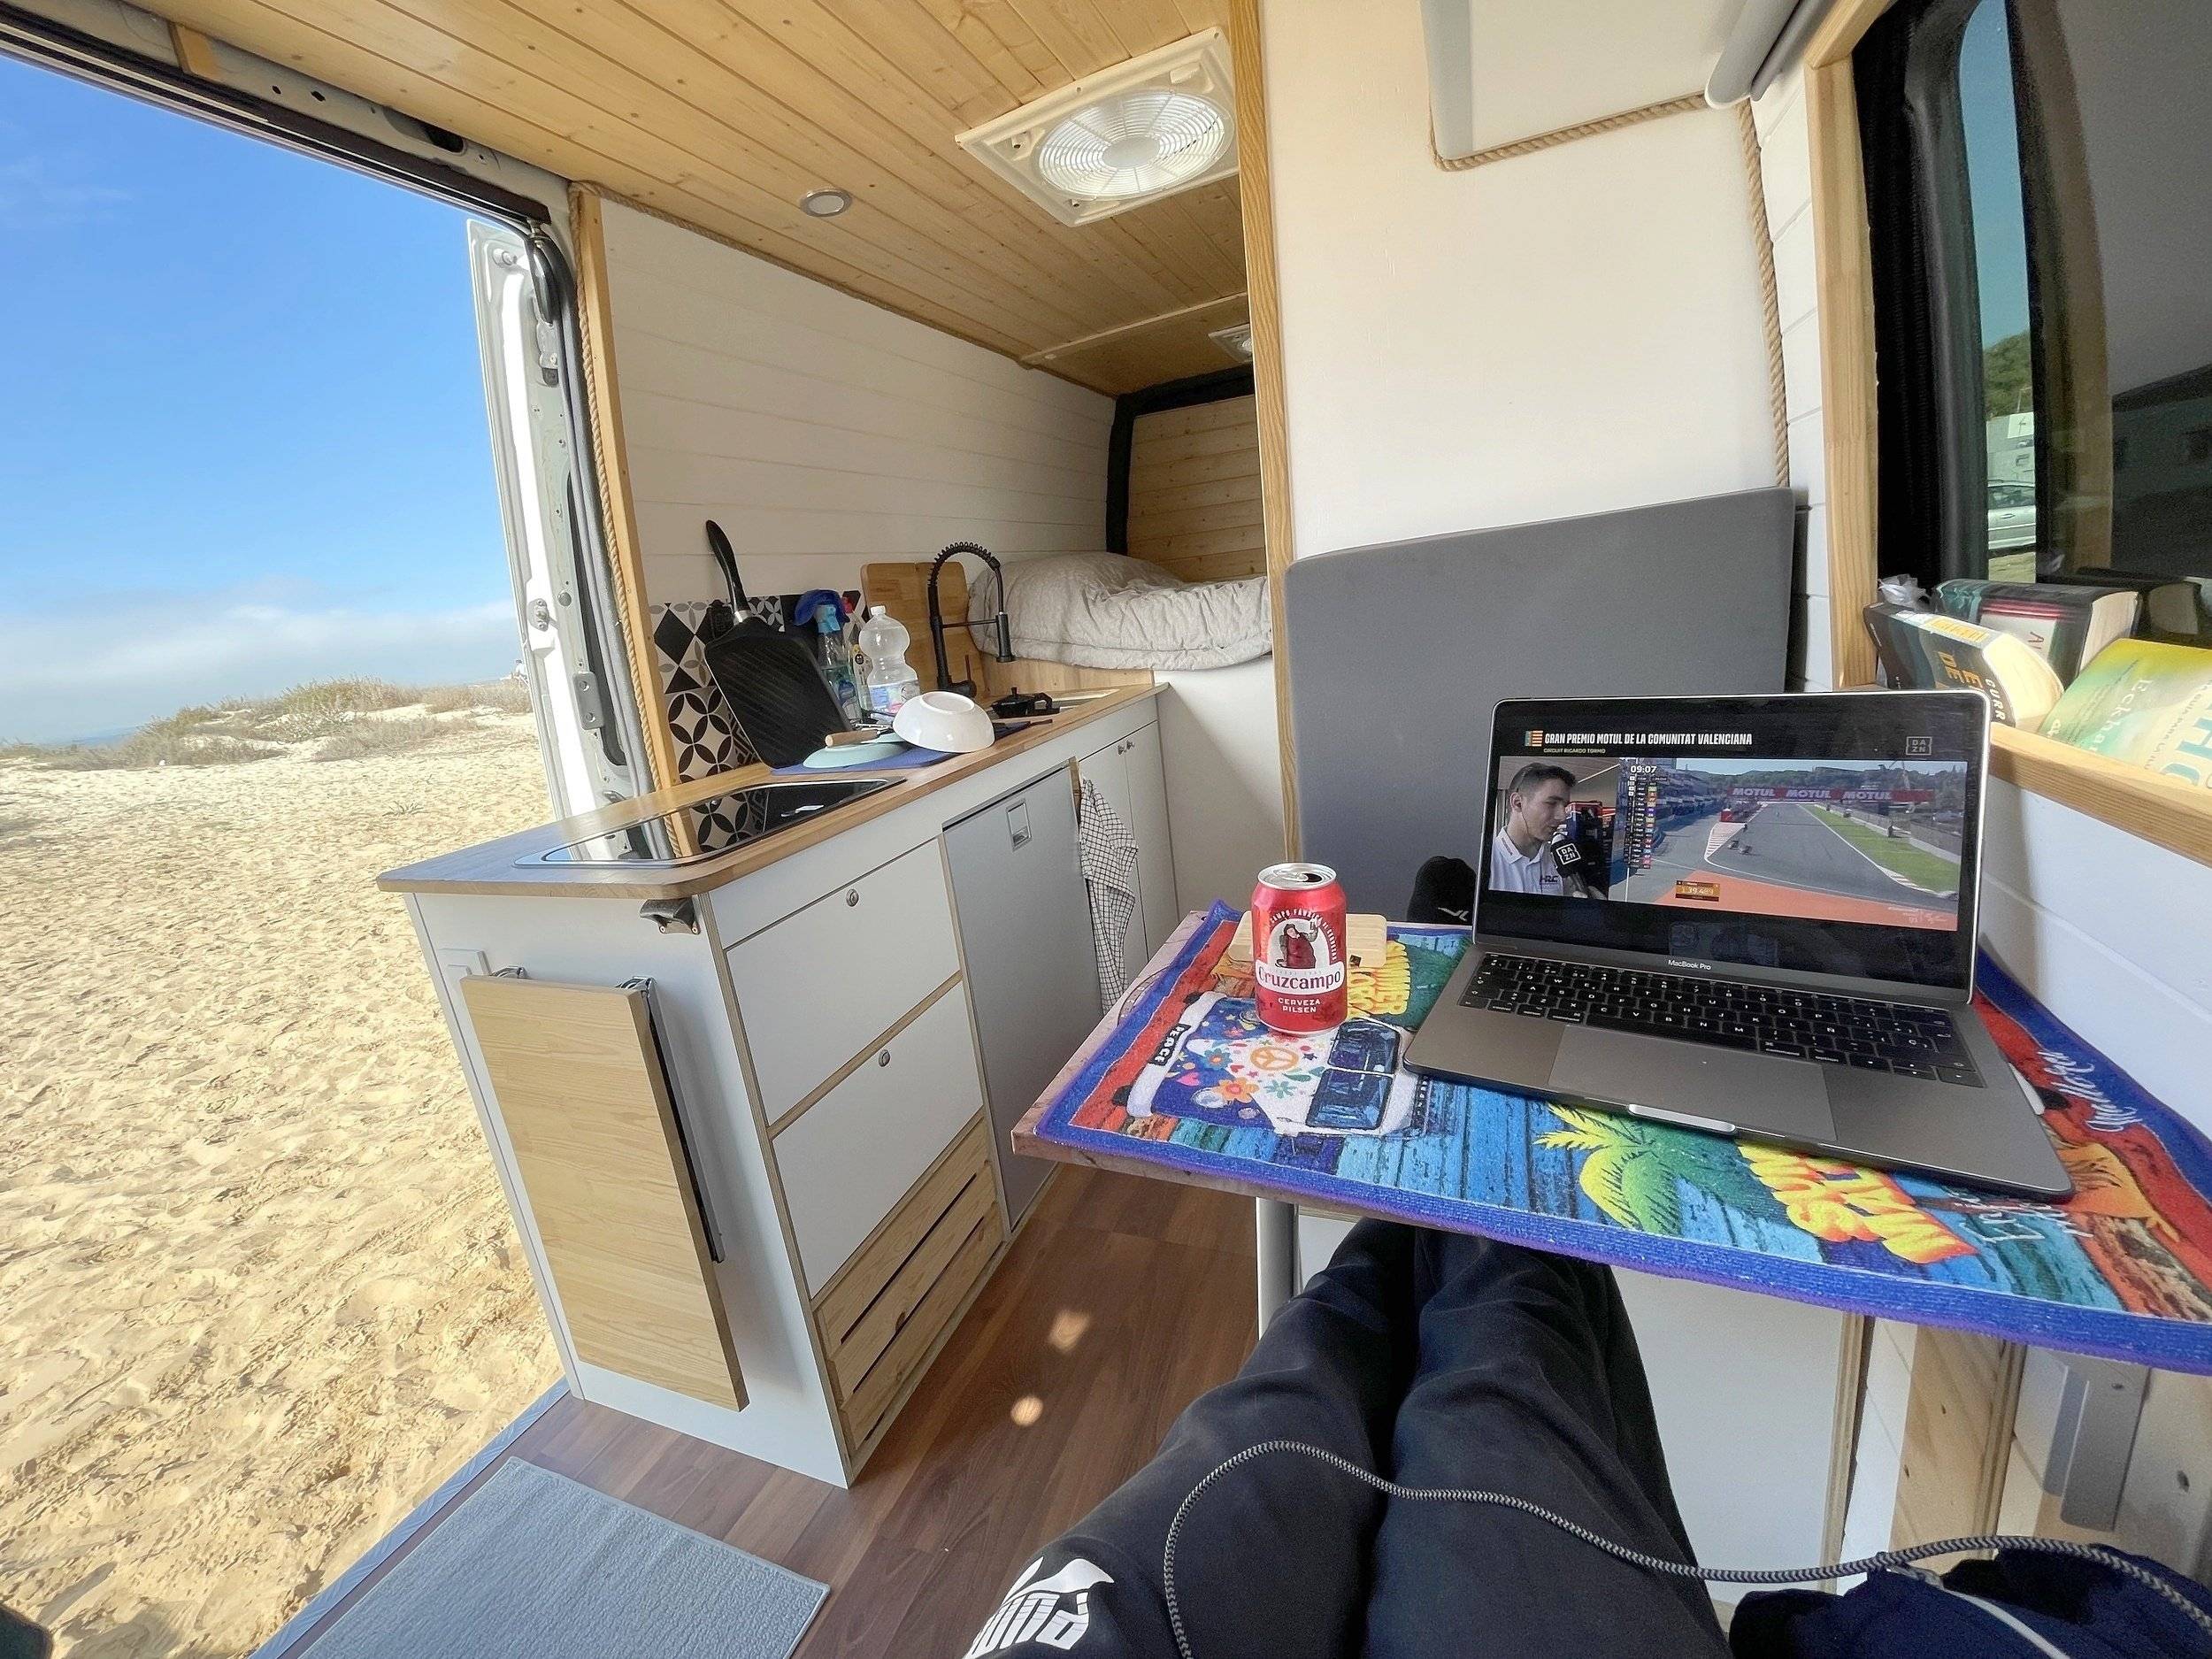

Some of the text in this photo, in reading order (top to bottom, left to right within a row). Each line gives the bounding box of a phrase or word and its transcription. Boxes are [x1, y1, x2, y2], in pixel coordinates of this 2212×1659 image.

[1544, 733, 1752, 745] GRAN PREMIO MOTUL DE LA COMUNITAT VALENCIANA
[1732, 787, 1776, 796] MOTUL
[1786, 789, 1832, 799] MOTUL
[1668, 959, 1699, 969] MacBook
[1258, 966, 1340, 989] Cruzcampo
[1278, 997, 1321, 1006] CERVEZA
